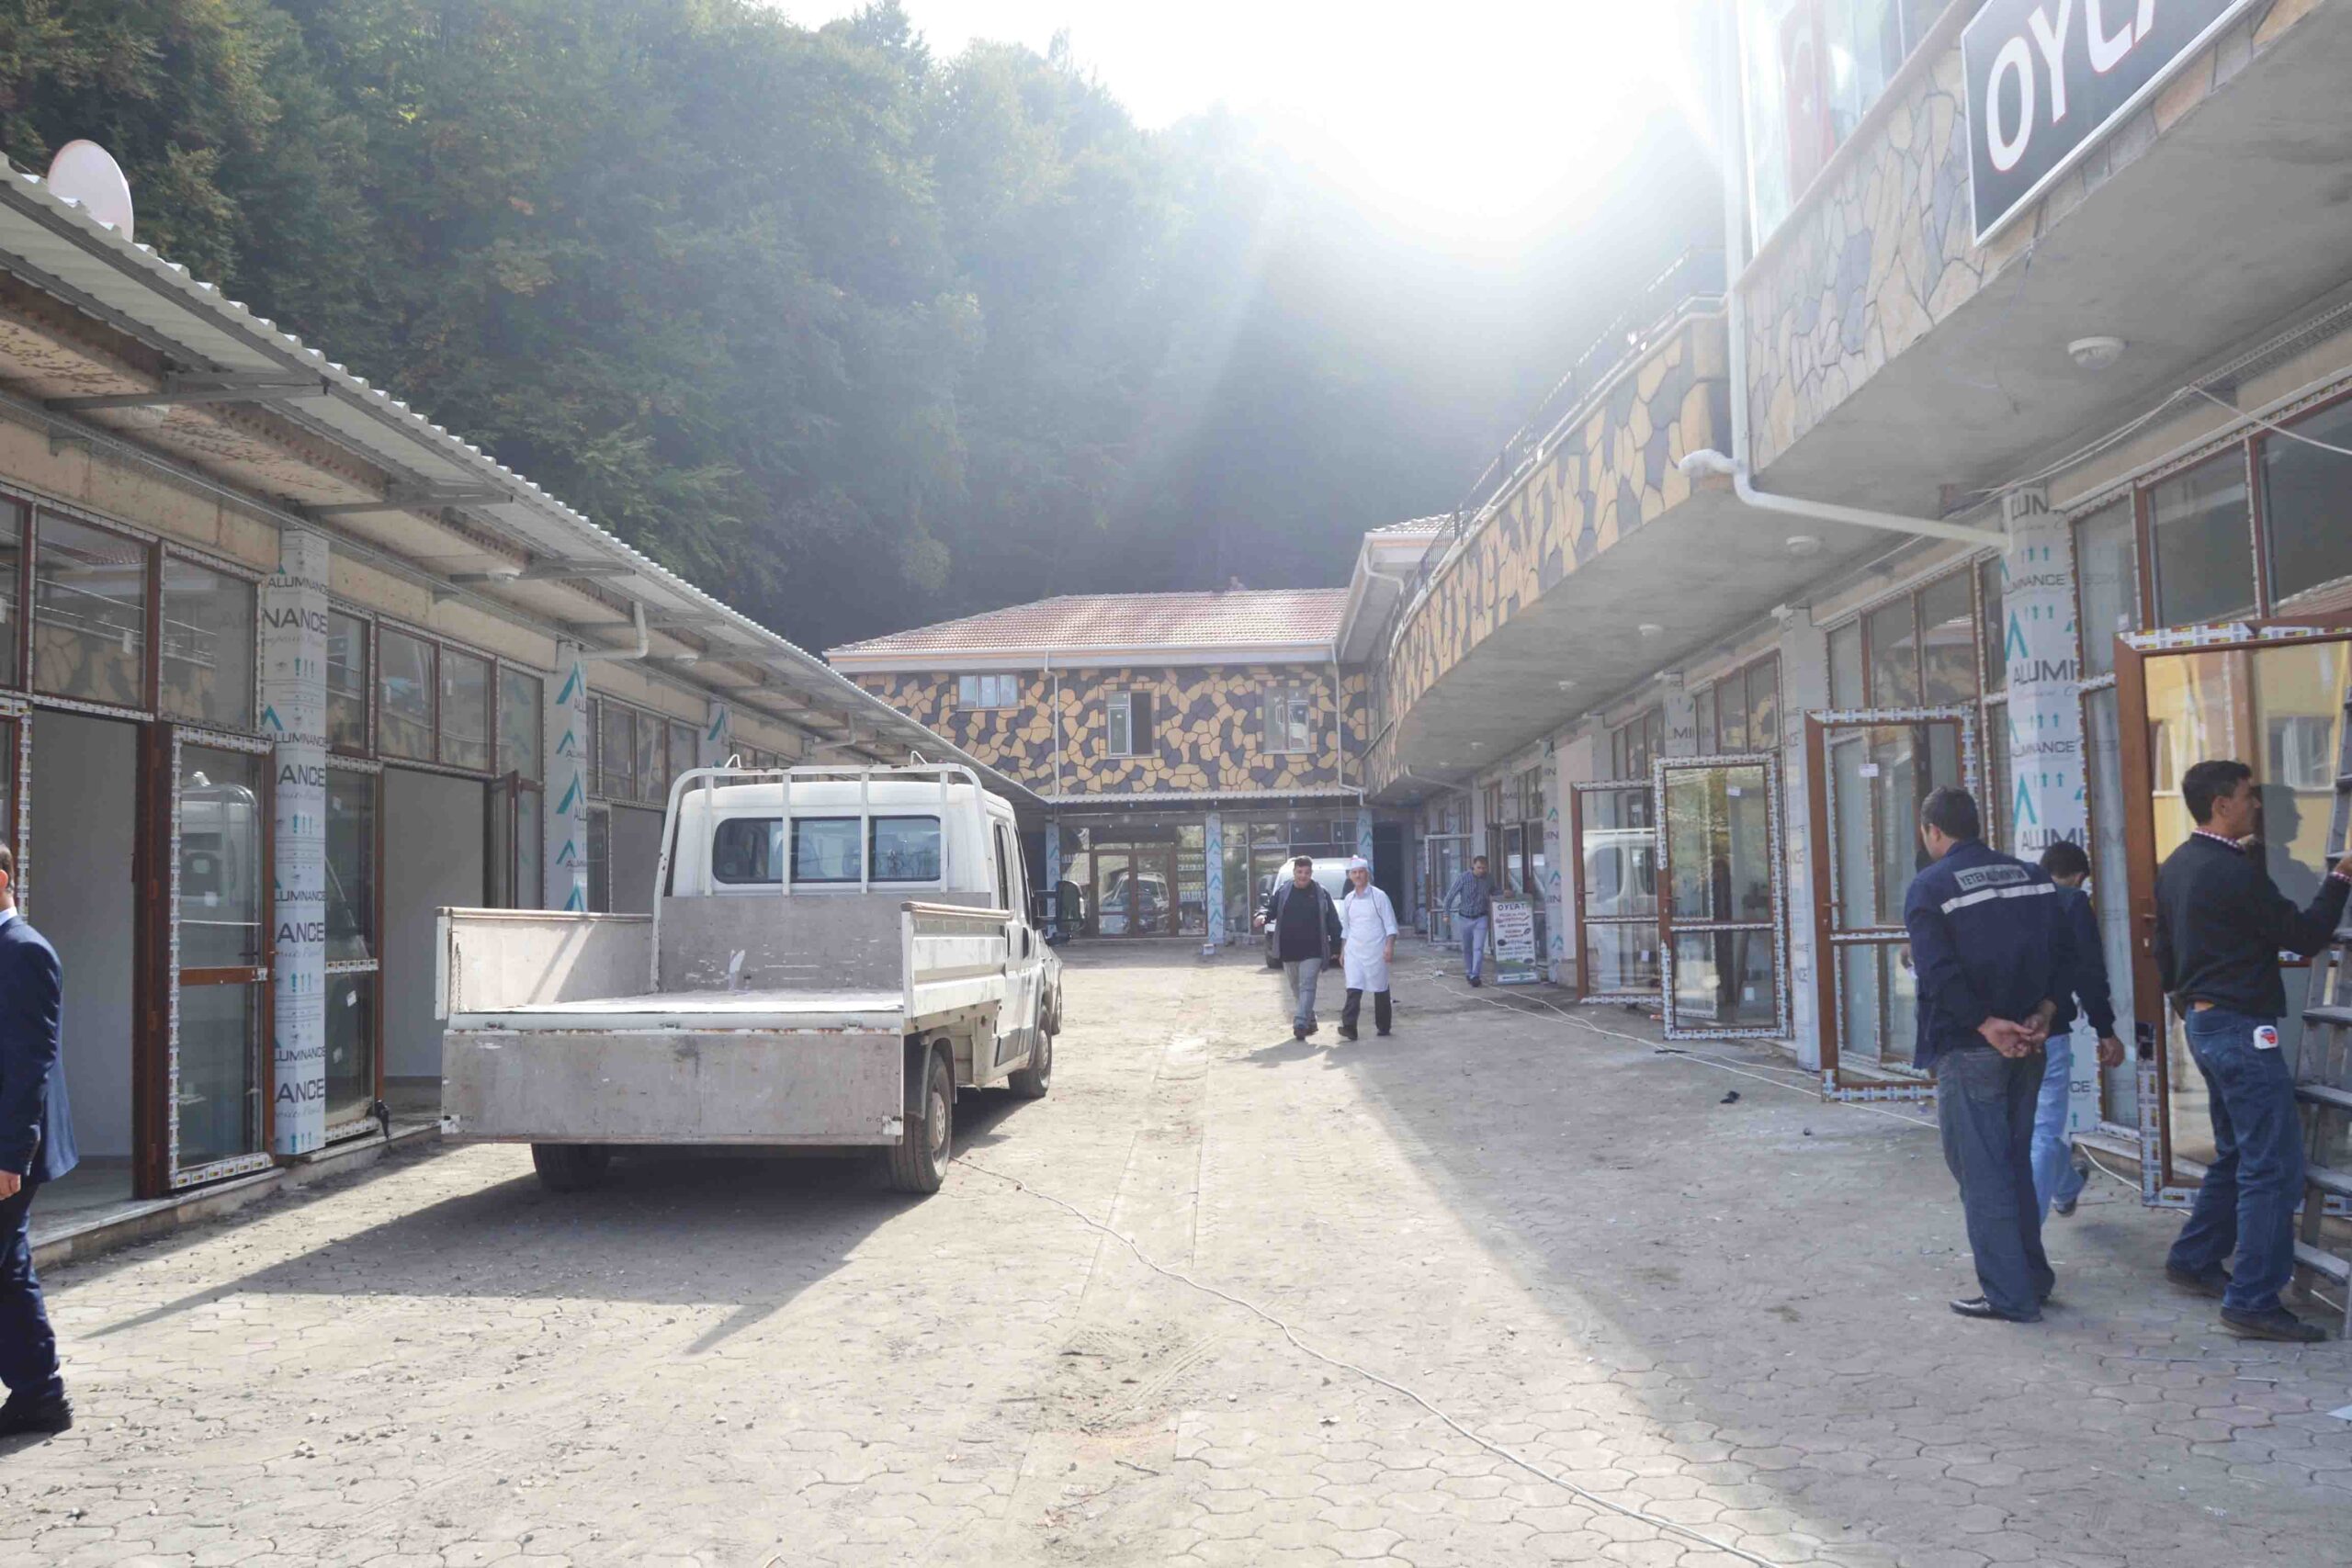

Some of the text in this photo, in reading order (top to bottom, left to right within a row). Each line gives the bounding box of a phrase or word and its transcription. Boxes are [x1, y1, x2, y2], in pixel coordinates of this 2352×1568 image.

[1985, 0, 2154, 172] OYL
[278, 763, 325, 787] ANCE
[277, 922, 324, 943] ANCE
[276, 1078, 324, 1103] ANCE
